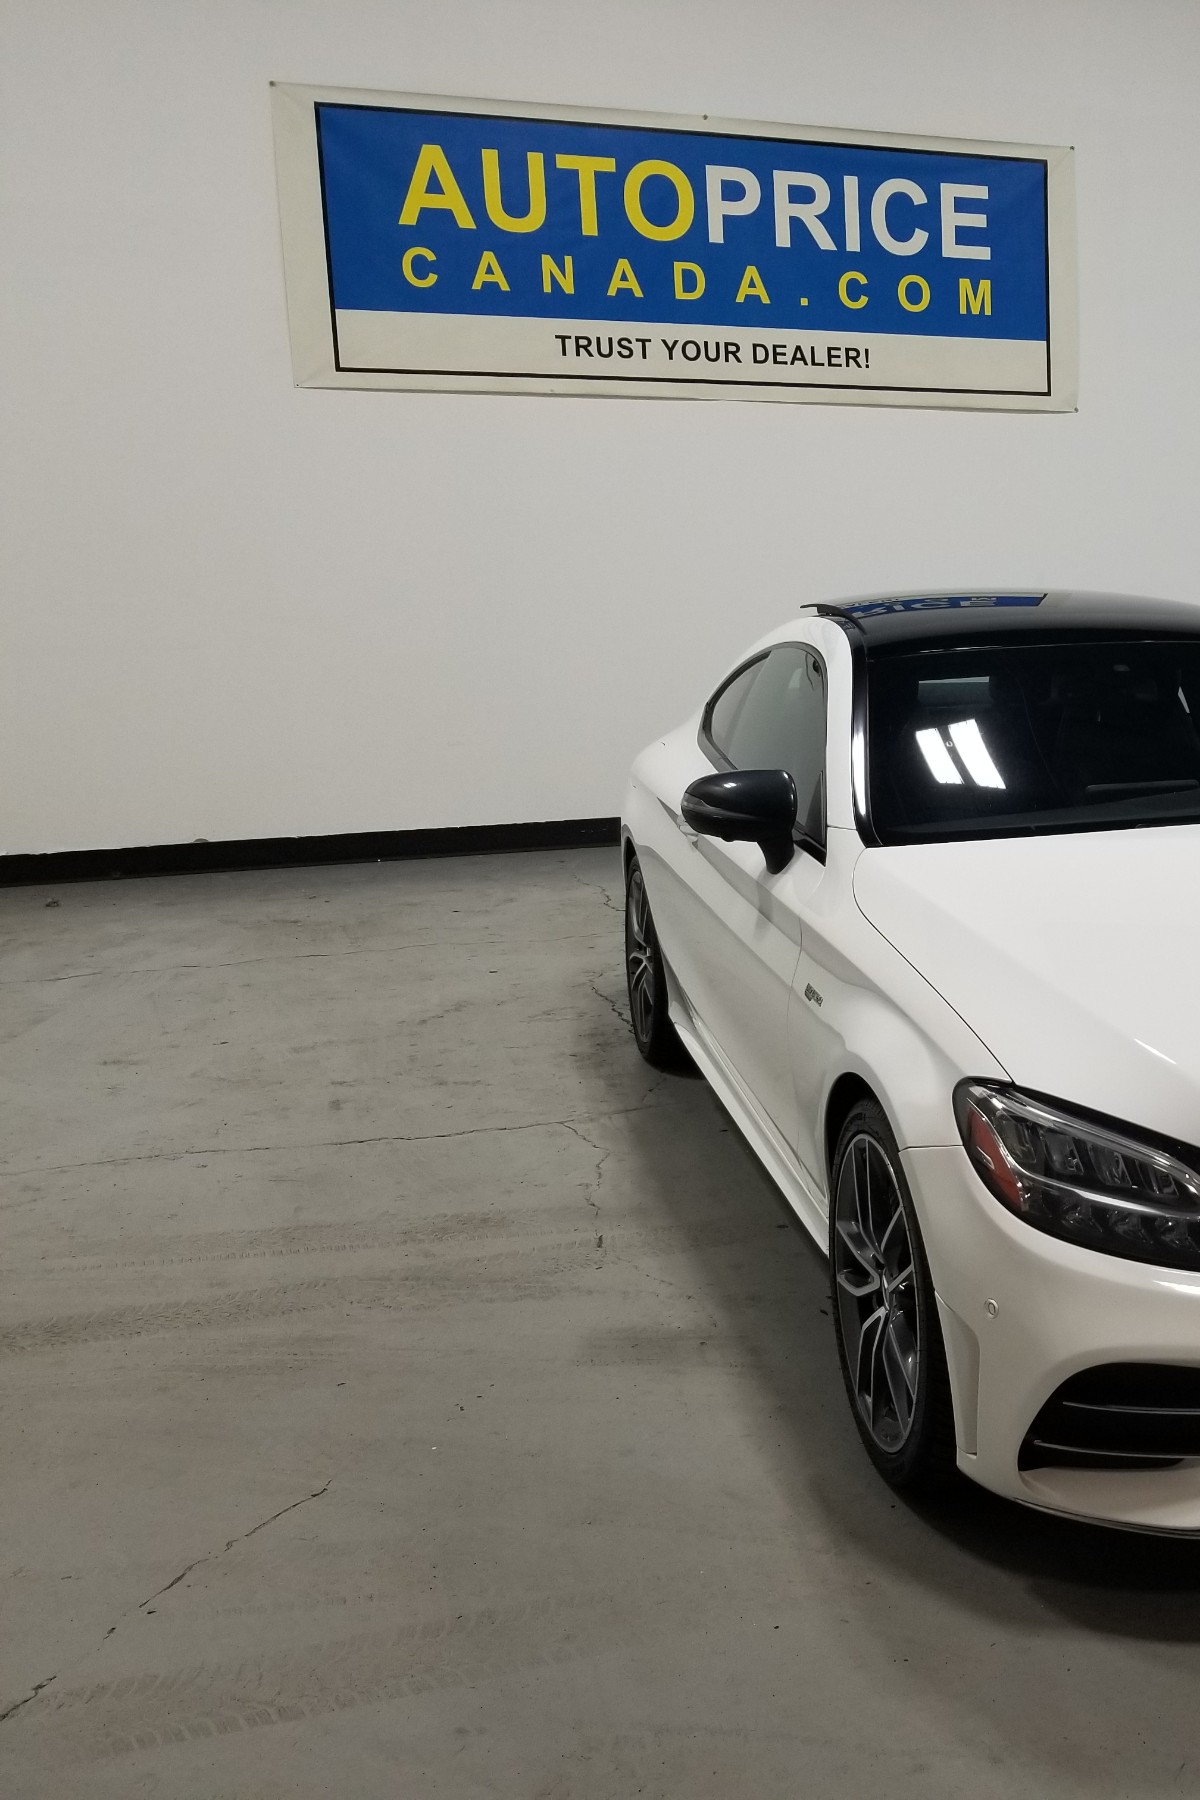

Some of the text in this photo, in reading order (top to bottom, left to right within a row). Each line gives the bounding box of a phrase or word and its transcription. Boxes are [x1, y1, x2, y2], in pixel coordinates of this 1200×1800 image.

[398, 144, 991, 261] AUTOPRICE
[402, 246, 992, 316] CANADA.COM
[554, 334, 871, 370] TRUST YOUR DEALER!
